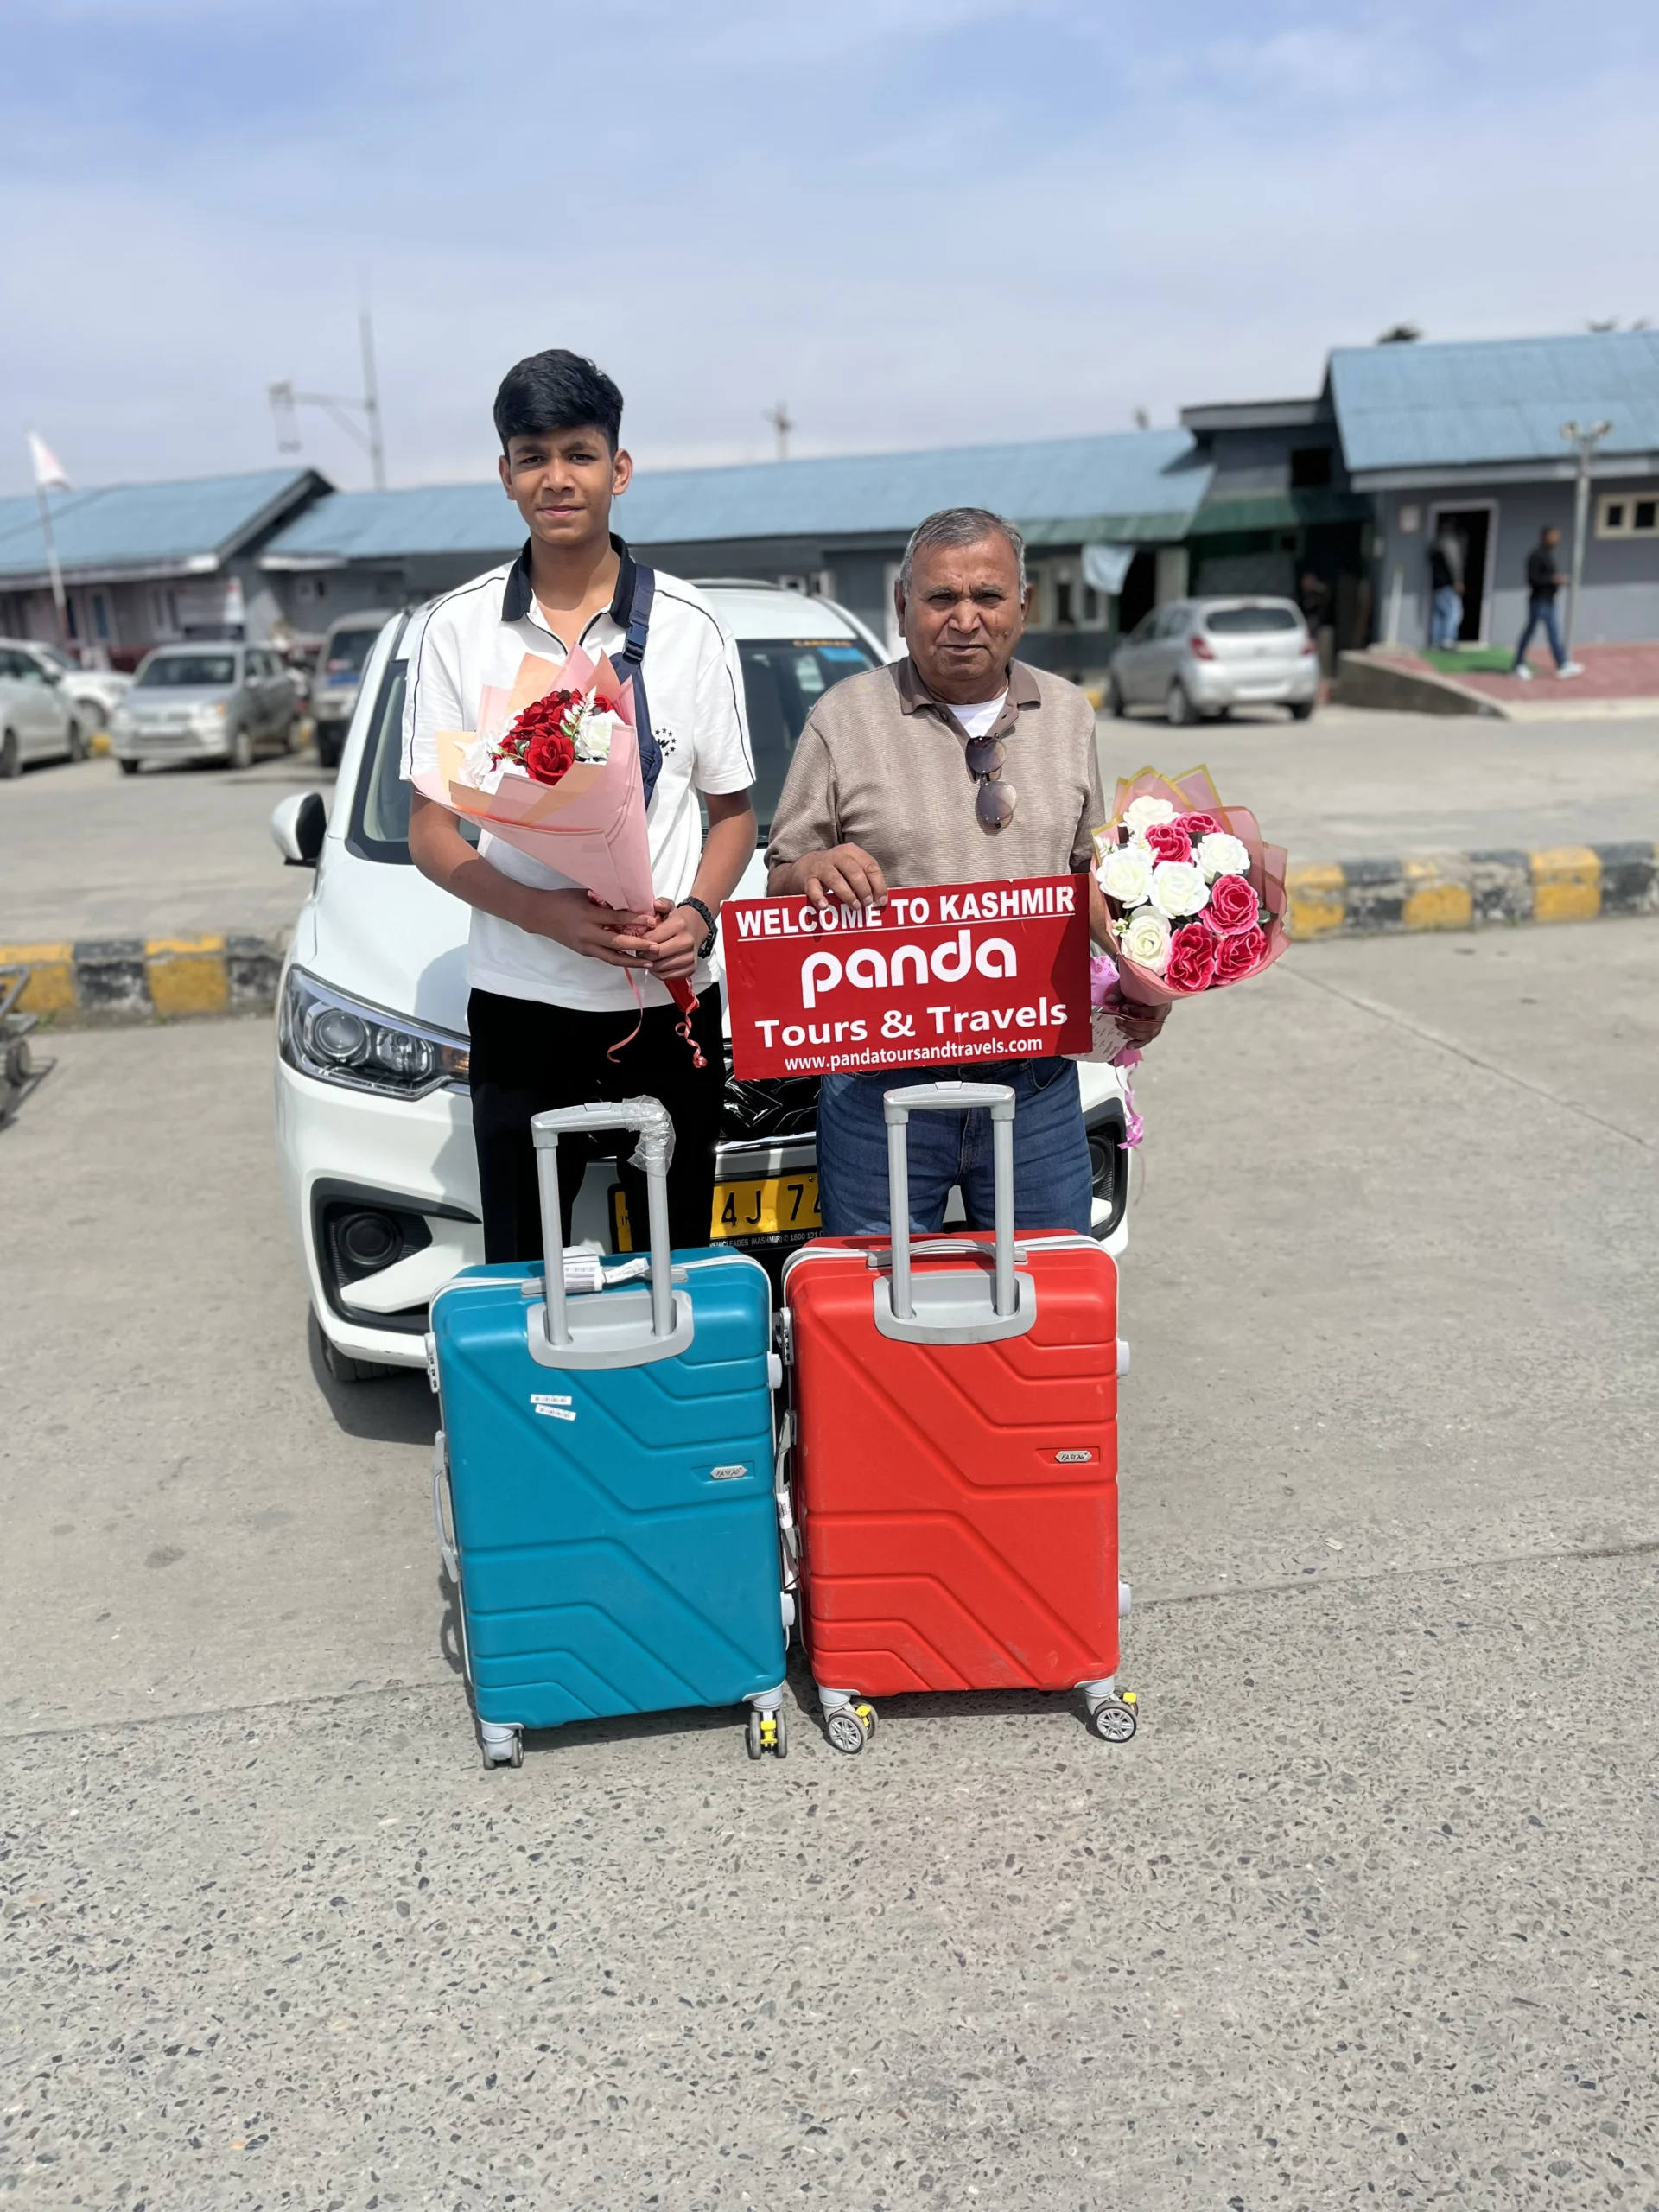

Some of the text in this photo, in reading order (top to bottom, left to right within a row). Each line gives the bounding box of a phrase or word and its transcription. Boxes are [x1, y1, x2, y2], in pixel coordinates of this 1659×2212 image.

[735, 886, 1075, 938] WELCOME TO KASHMIR
[801, 929, 1017, 1009] panda
[755, 997, 1068, 1048] Tours & Travels
[785, 1037, 1042, 1071] www.pandatoursandtravels.com
[751, 1235, 783, 1246] (KASHMIR)
[790, 1232, 806, 1242] 1800
